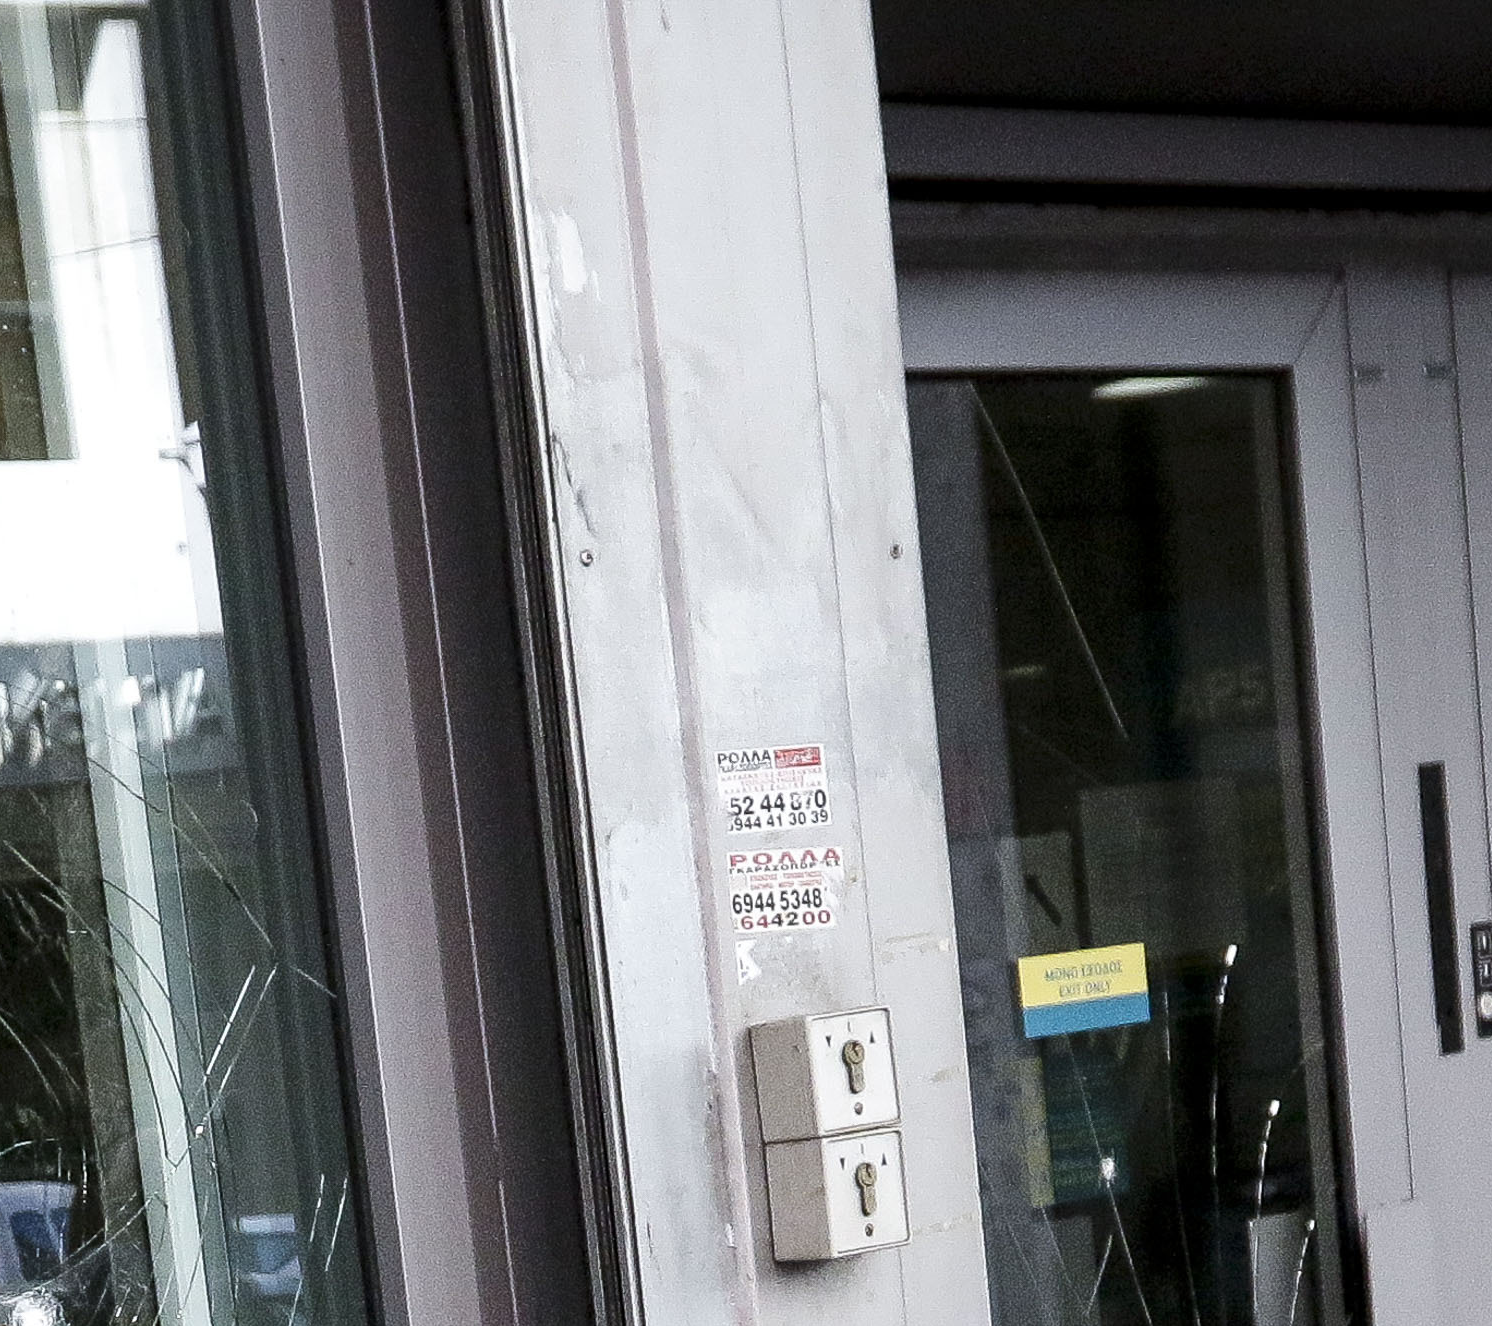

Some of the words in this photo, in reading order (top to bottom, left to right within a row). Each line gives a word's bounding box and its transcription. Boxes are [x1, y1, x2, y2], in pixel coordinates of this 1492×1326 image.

[730, 796, 754, 817] 52
[760, 792, 785, 812] 44
[729, 816, 761, 832] 944
[767, 814, 782, 828] 41
[789, 812, 806, 826] 30
[811, 809, 828, 823] 39
[729, 860, 840, 874] ΓΚΑΡΑΖΟΠΟΡΕΣ
[730, 848, 840, 867] ΡΟΛΛΑ
[732, 891, 775, 914] 6944
